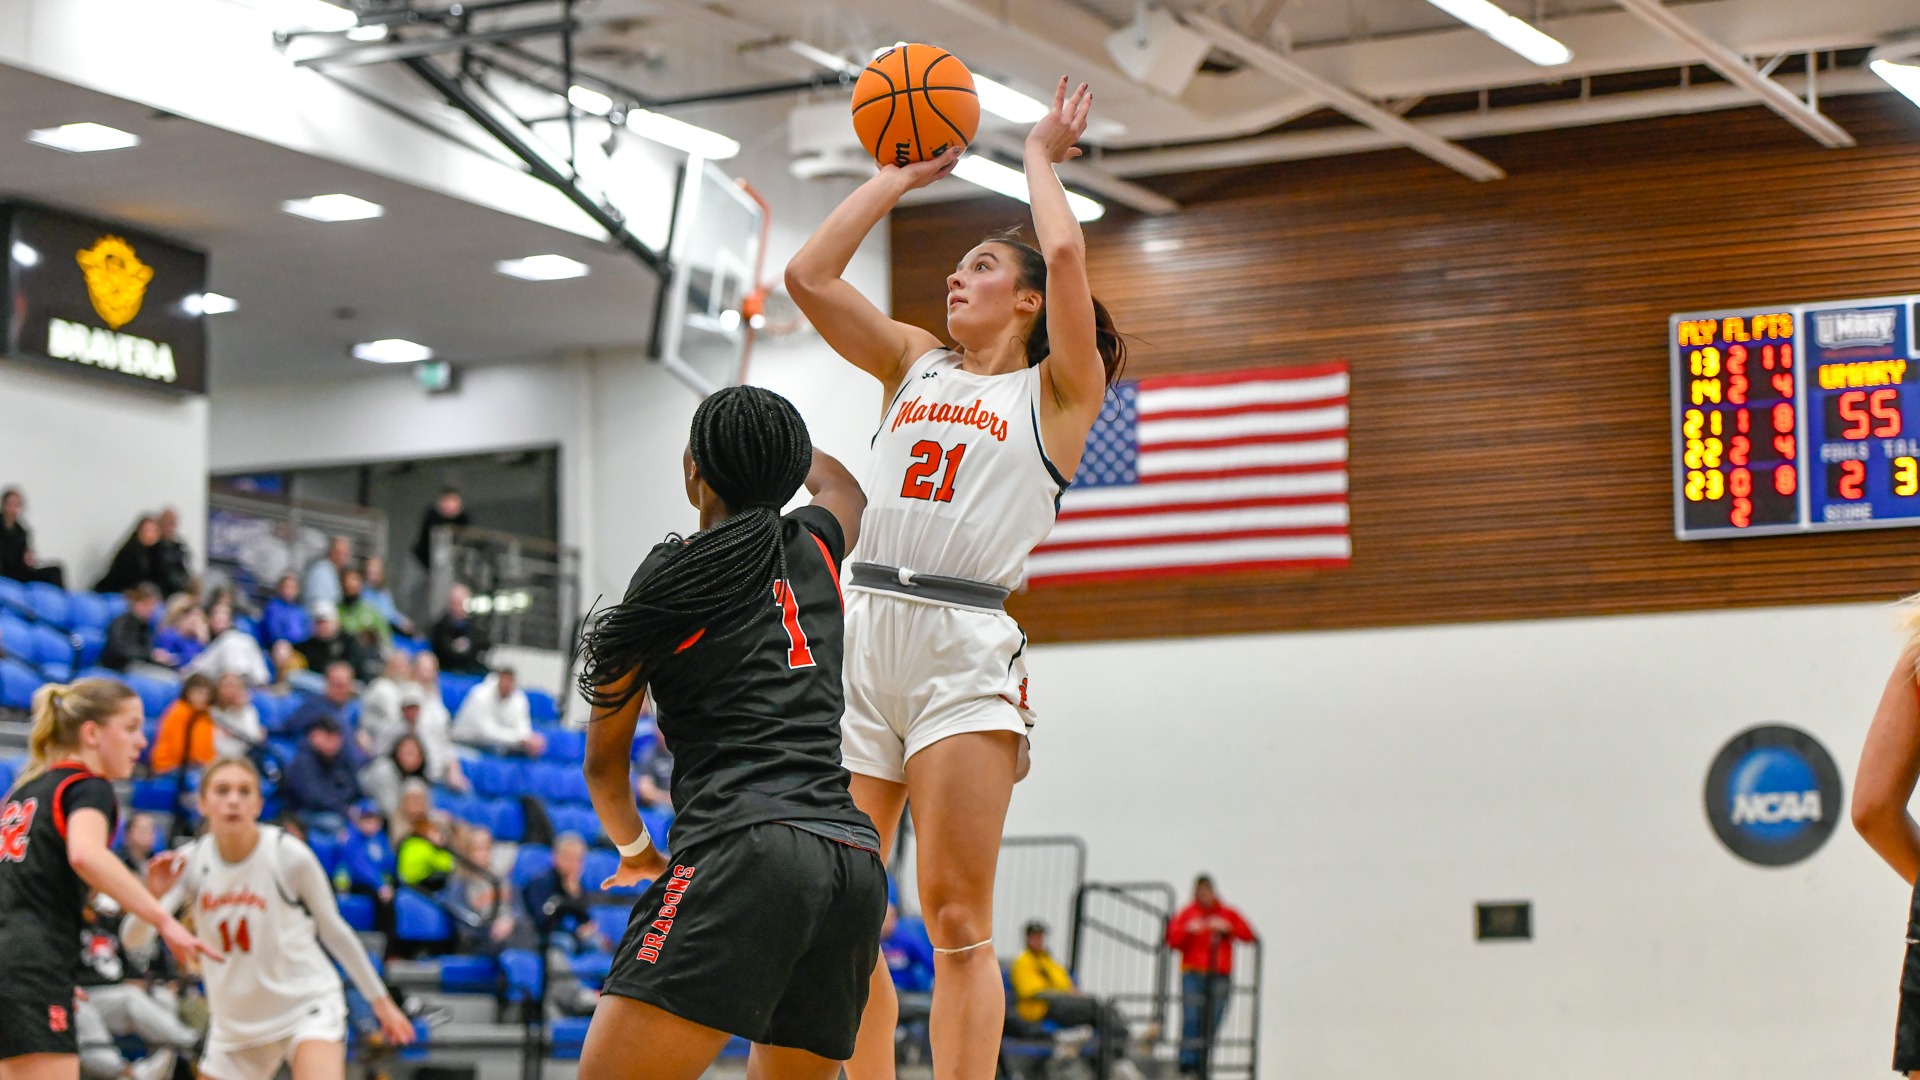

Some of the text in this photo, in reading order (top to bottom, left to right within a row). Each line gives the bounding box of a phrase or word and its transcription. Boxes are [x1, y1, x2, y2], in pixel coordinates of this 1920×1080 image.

[1752, 313, 1793, 340] PTS
[1691, 344, 1792, 377] 13 2 11
[1691, 373, 1793, 405] 14 2 4
[891, 395, 1008, 442] Marauders
[1683, 409, 1722, 439] 21
[1737, 408, 1749, 433] 1
[1839, 389, 1902, 440] 55
[1684, 435, 1795, 469] 22 2 4
[900, 439, 967, 503] 21
[1685, 469, 1724, 501] 23
[1730, 467, 1752, 498] 0
[1839, 459, 1865, 500] 2
[1893, 455, 1919, 497] 3
[1730, 498, 1752, 528] 2
[773, 579, 817, 669] 1
[1731, 789, 1823, 825] NCAA
[636, 864, 695, 965] DRAGONS
[219, 917, 251, 954] 14
